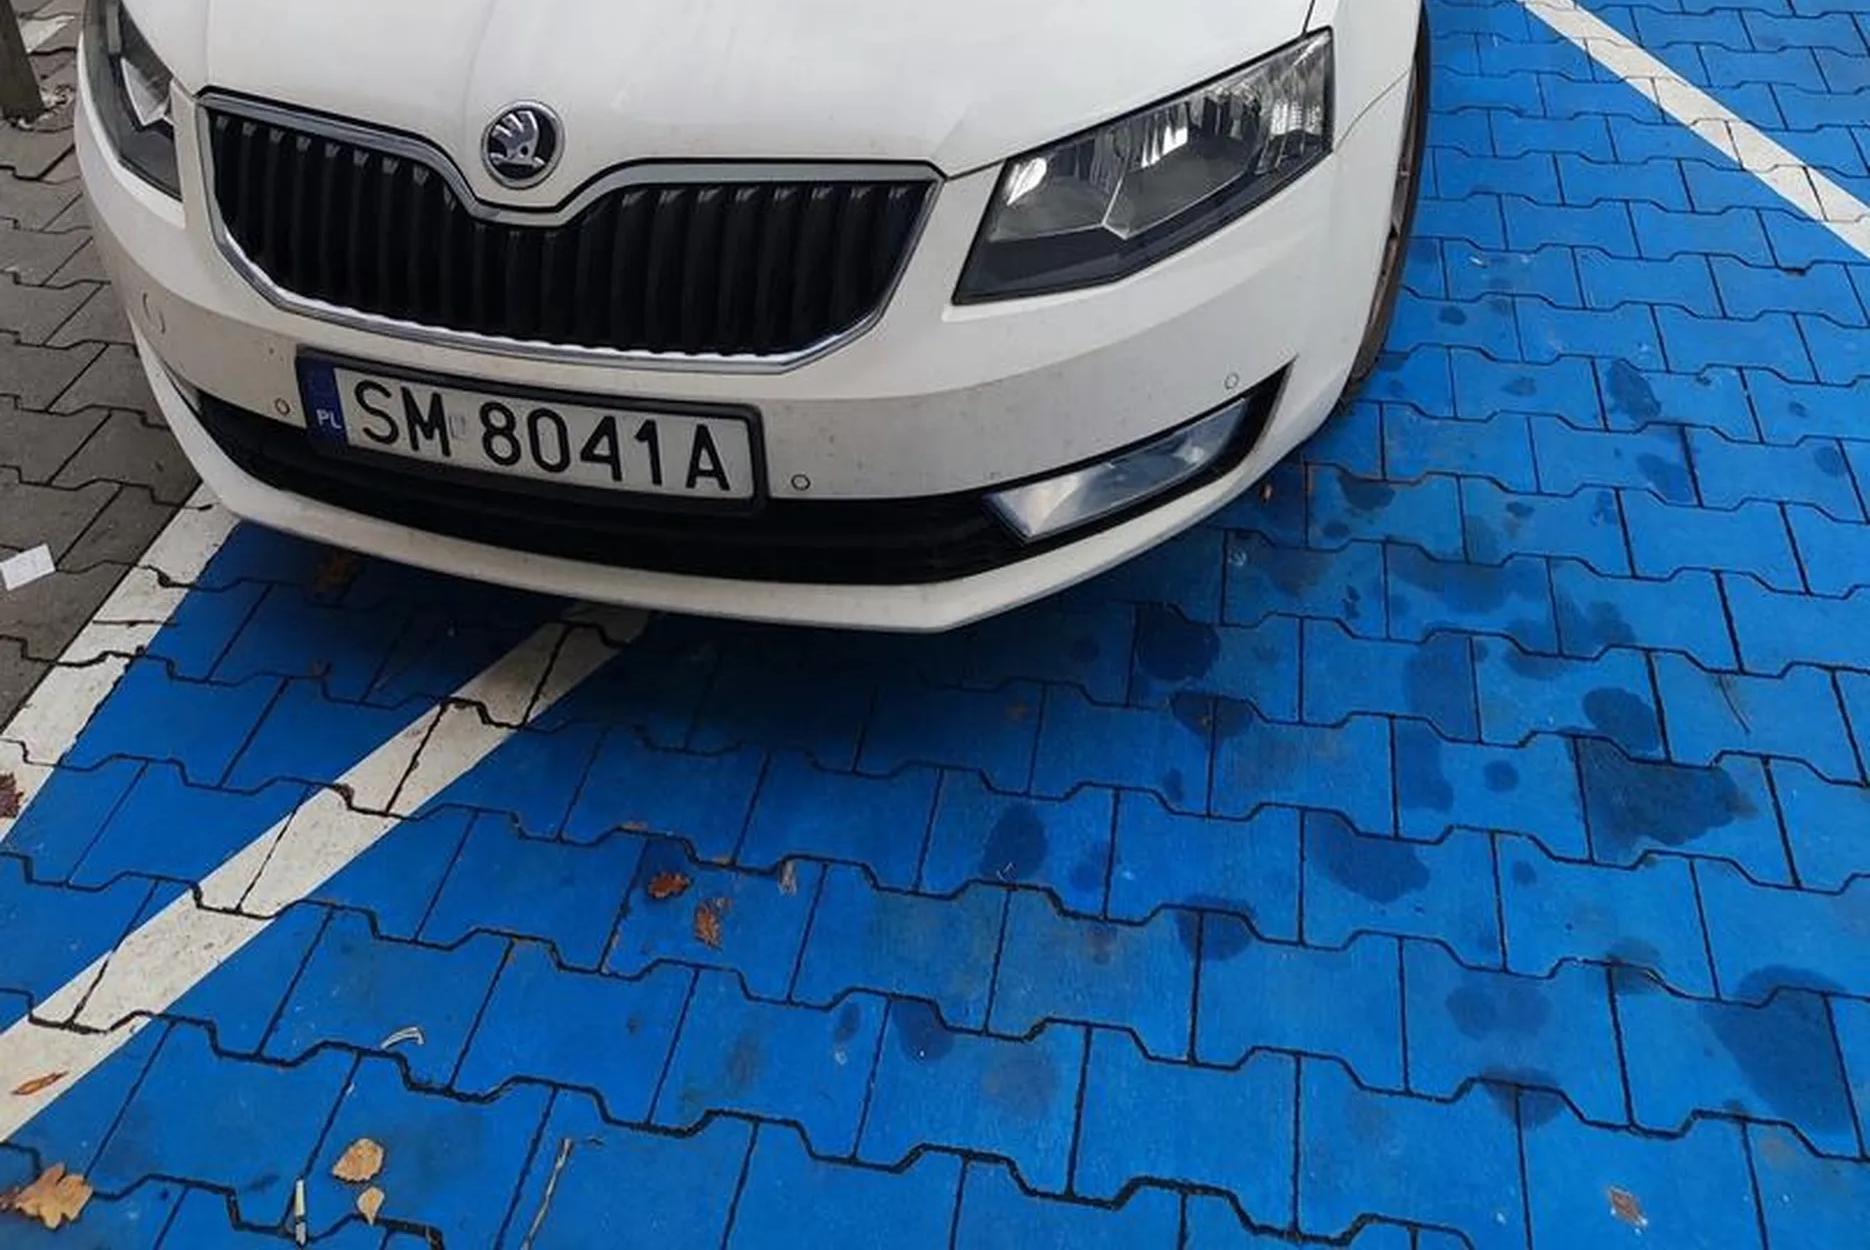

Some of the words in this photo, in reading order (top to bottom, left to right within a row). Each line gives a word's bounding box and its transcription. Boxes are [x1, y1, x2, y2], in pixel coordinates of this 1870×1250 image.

[316, 409, 342, 429] PL
[354, 380, 451, 457] SM
[479, 402, 731, 491] 8041A
